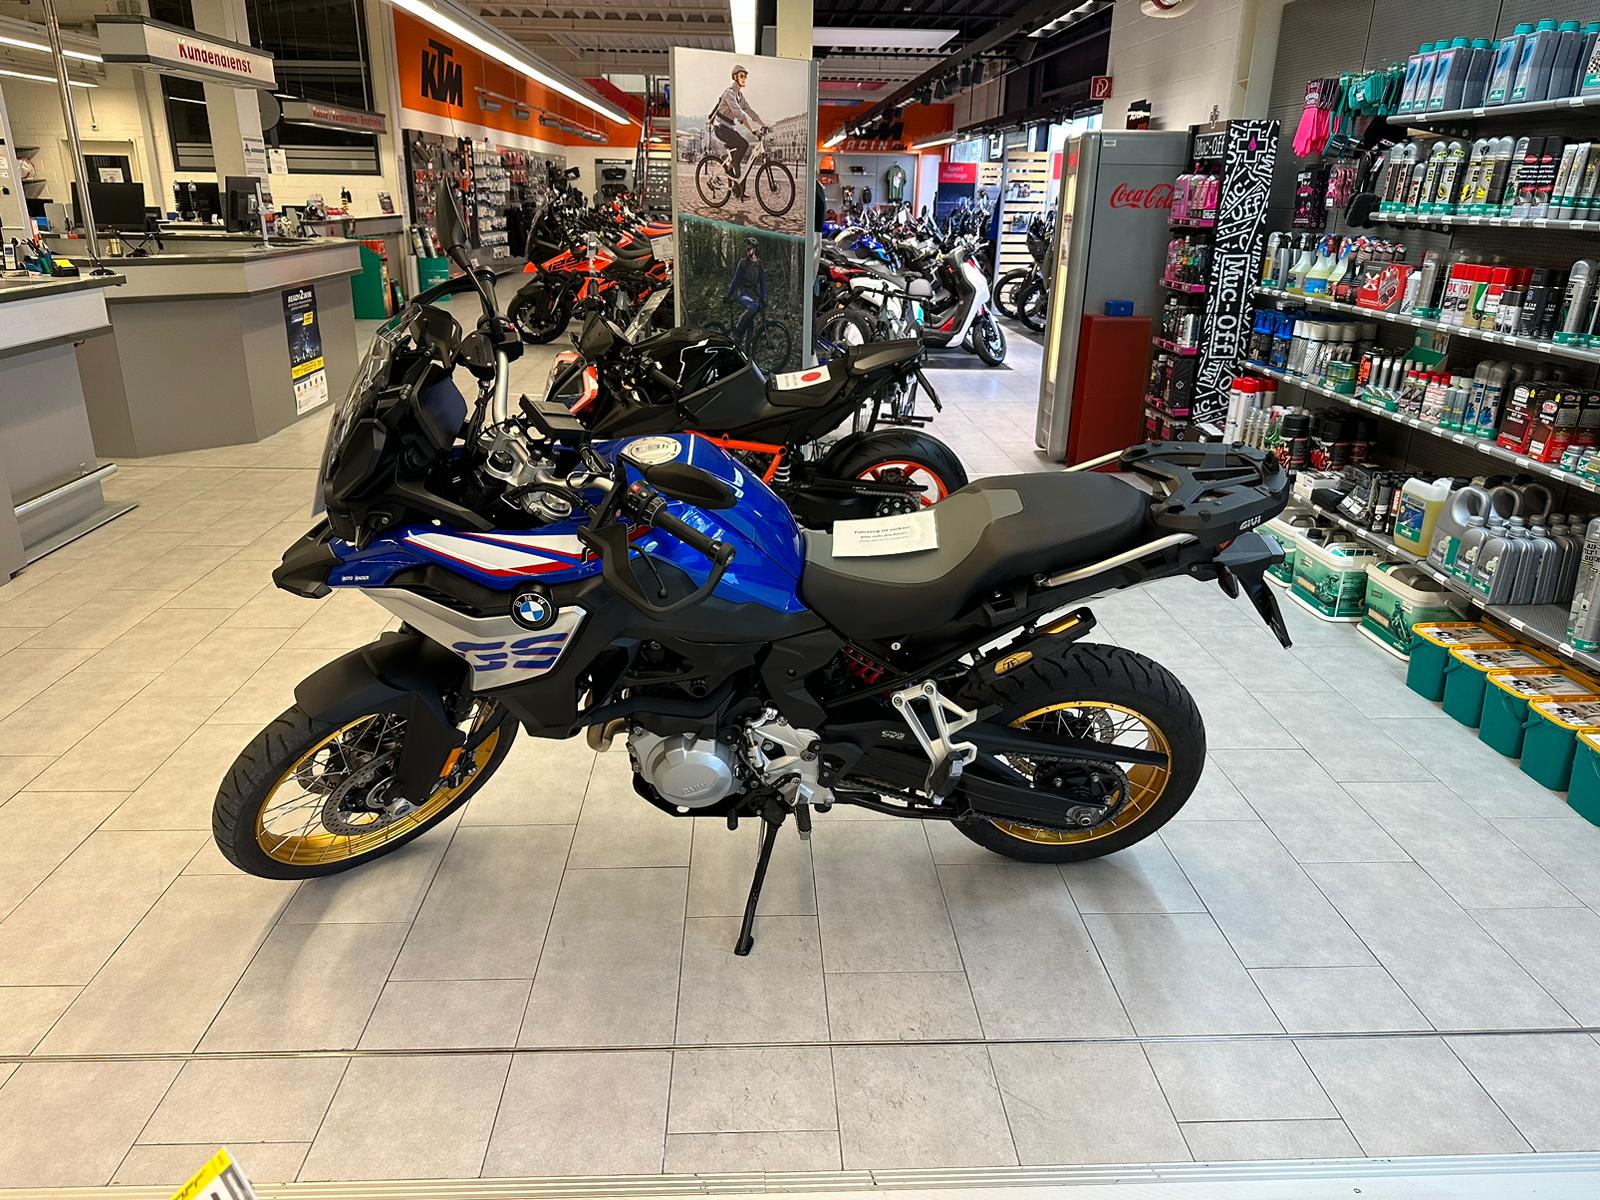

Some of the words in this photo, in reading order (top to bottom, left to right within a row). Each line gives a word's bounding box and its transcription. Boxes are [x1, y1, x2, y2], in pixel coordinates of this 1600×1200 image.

[177, 39, 253, 74] Kundendienst
[421, 38, 464, 108] KTM
[1194, 135, 1226, 156] Muc-Off
[942, 172, 968, 180] Heritage
[1239, 515, 1262, 530] GIVI
[514, 595, 545, 608] BMW
[452, 632, 569, 673] GS
